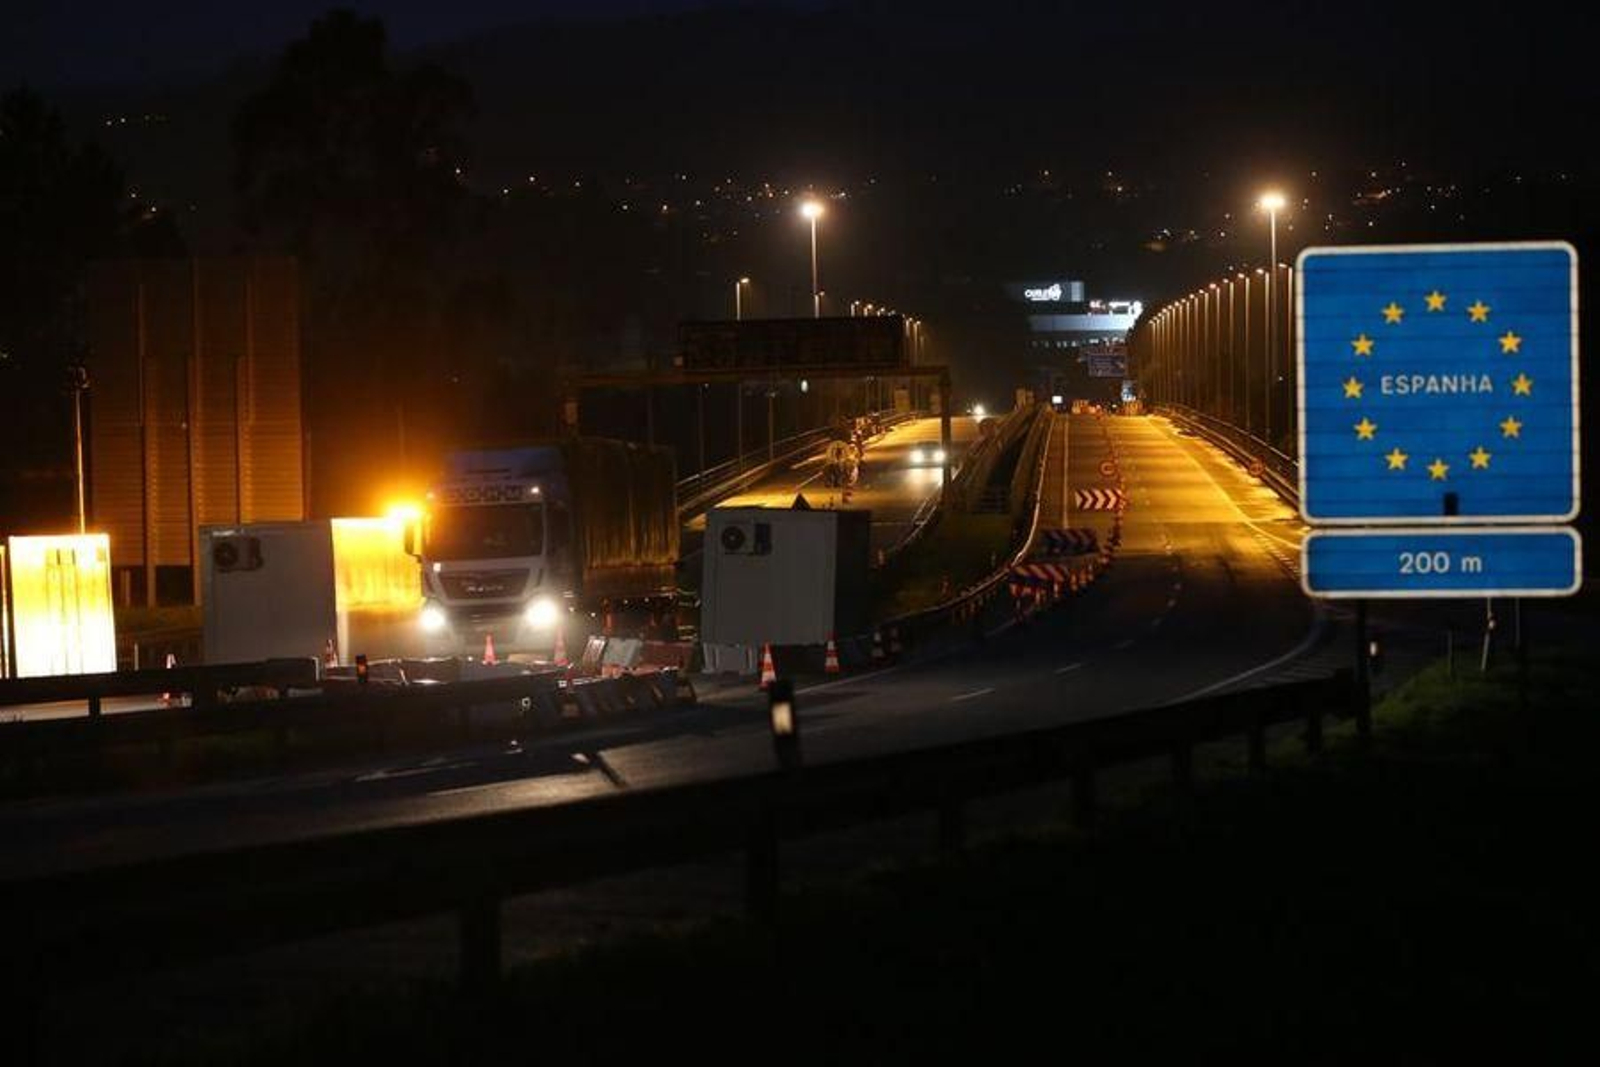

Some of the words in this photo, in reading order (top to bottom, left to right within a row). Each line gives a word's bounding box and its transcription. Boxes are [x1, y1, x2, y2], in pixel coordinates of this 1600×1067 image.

[1380, 373, 1494, 396] ESPANHA
[1398, 550, 1451, 575] 200
[1460, 555, 1483, 574] m
